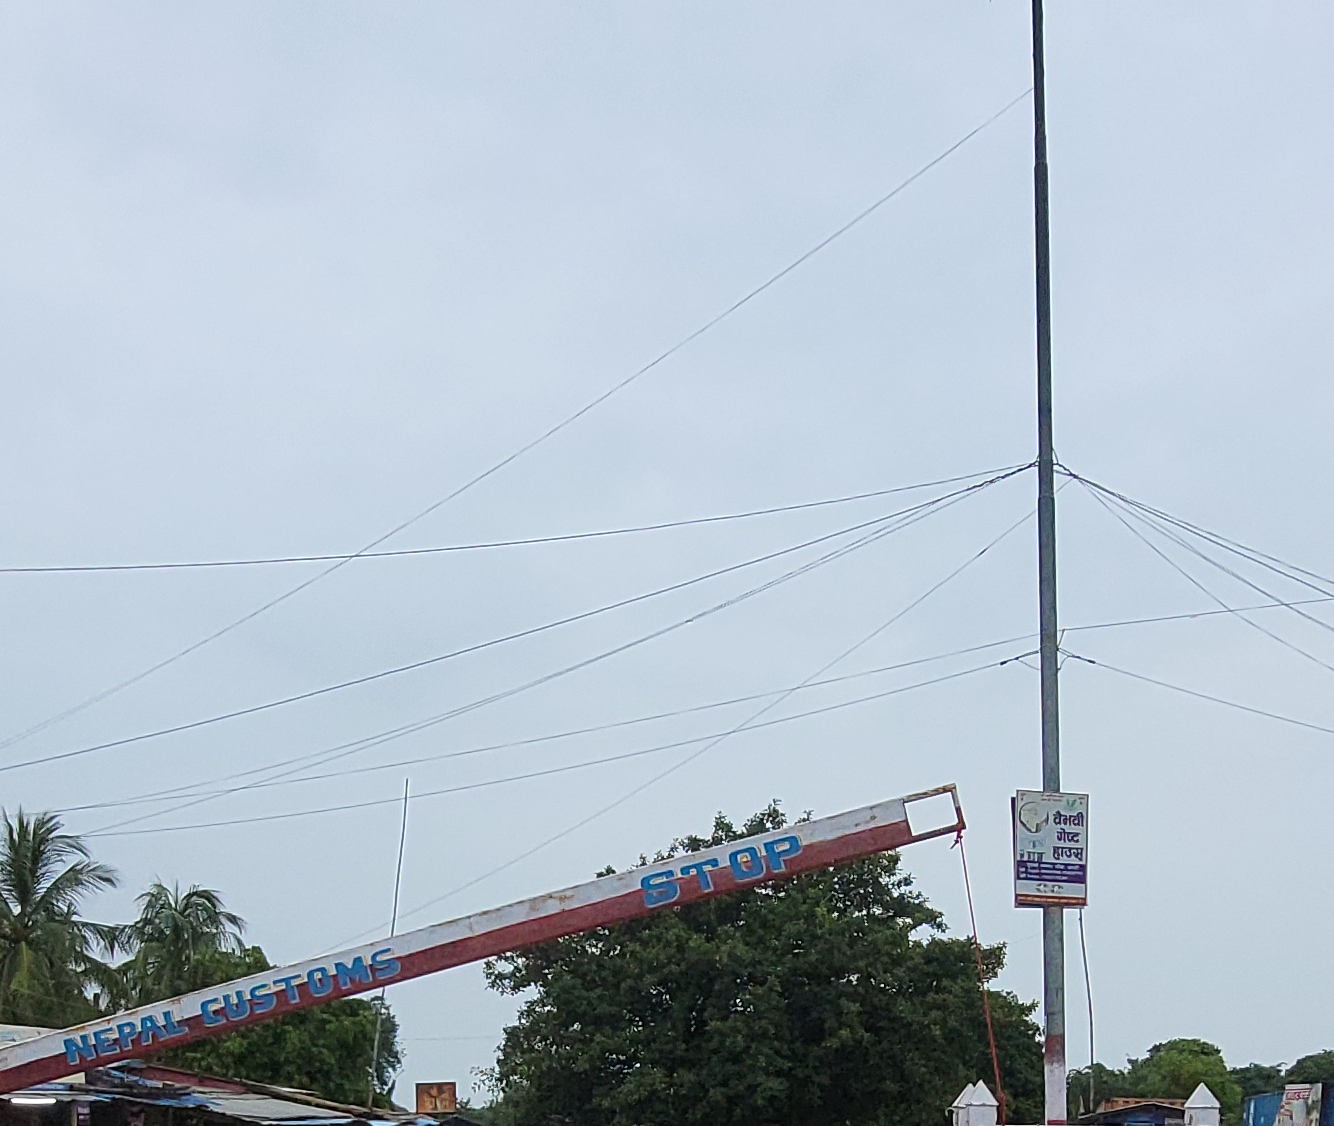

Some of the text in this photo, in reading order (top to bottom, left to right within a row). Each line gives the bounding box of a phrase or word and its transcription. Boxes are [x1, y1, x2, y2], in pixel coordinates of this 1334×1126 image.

[640, 834, 803, 907] STOP
[63, 947, 401, 1065] NEPAL CUSTOMS
